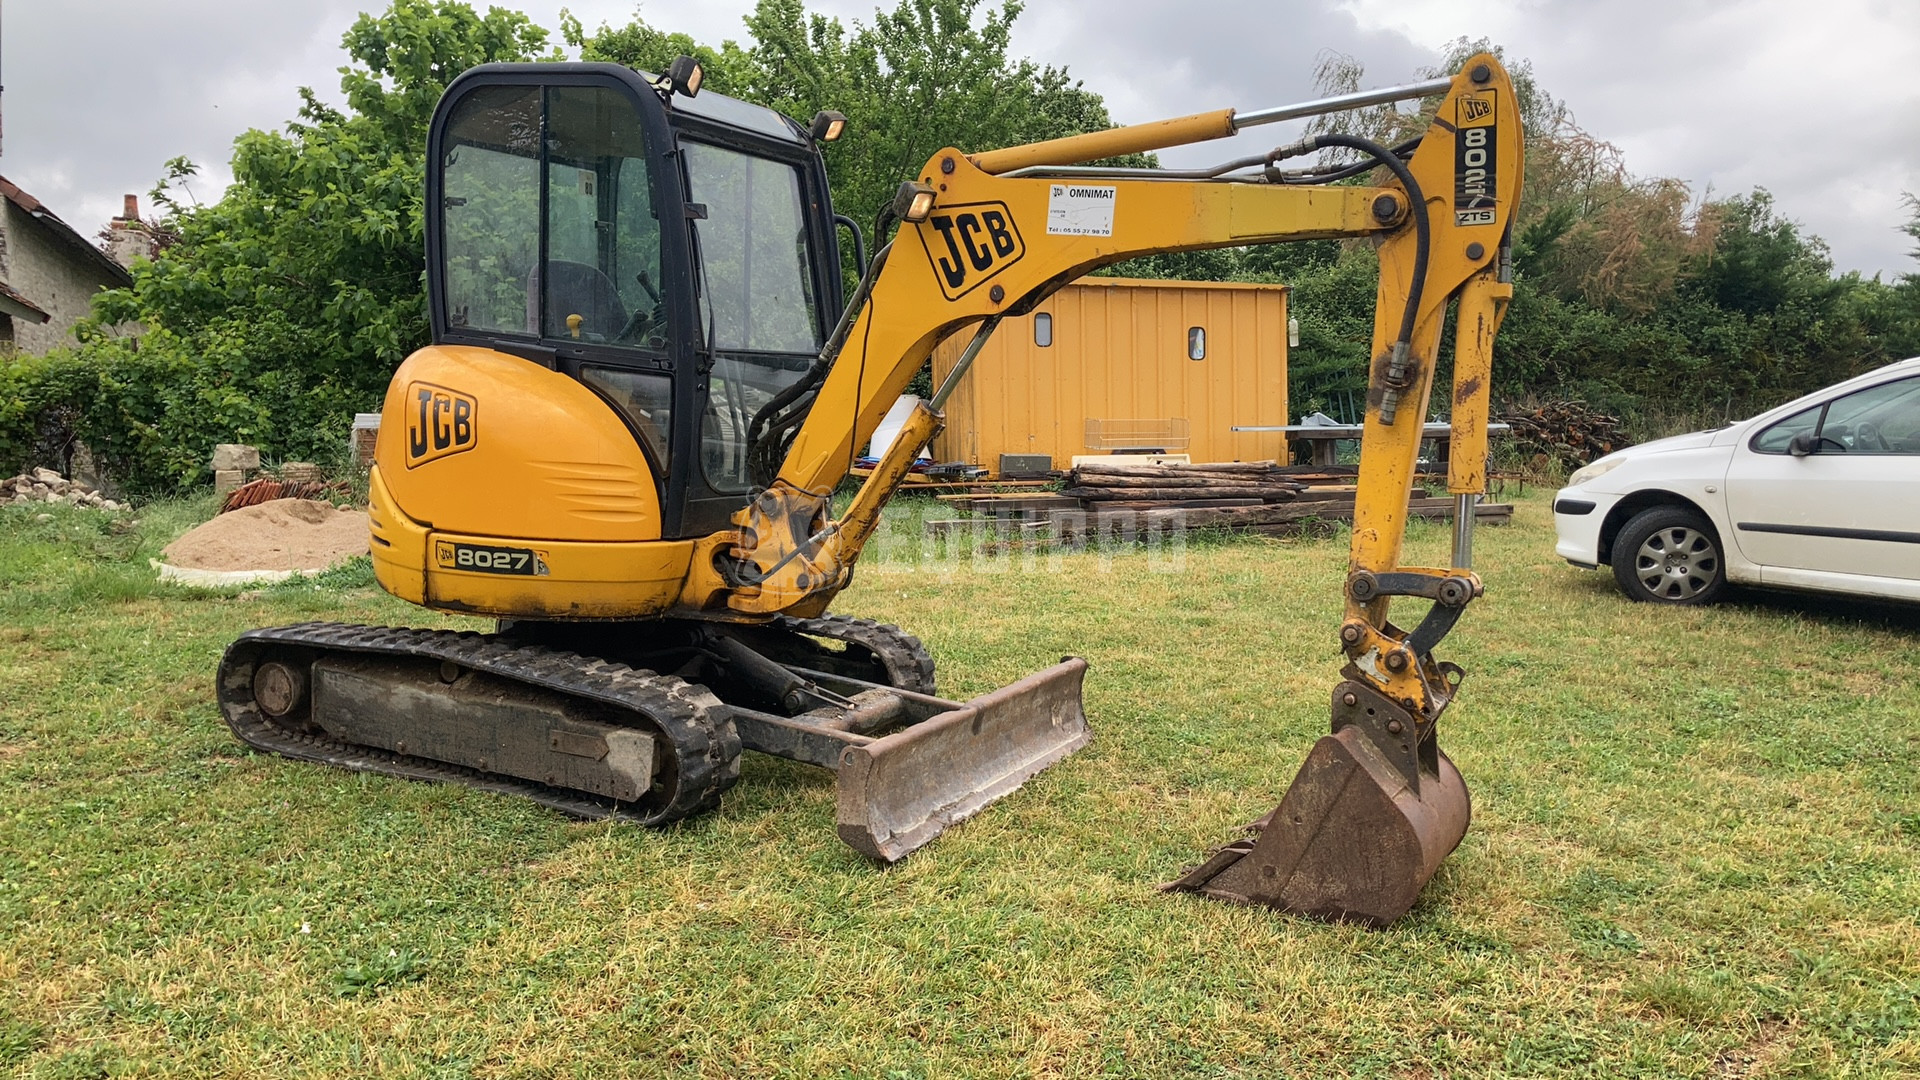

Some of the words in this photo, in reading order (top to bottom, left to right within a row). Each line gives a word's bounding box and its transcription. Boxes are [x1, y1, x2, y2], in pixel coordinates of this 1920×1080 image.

[1467, 101, 1489, 120] JCB
[1465, 128, 1487, 209] 8027
[1069, 188, 1114, 199] OMNIMAT
[1460, 211, 1491, 222] ZTS
[930, 210, 1015, 288] JCB
[410, 389, 470, 459] JCB
[457, 548, 530, 570] 8027
